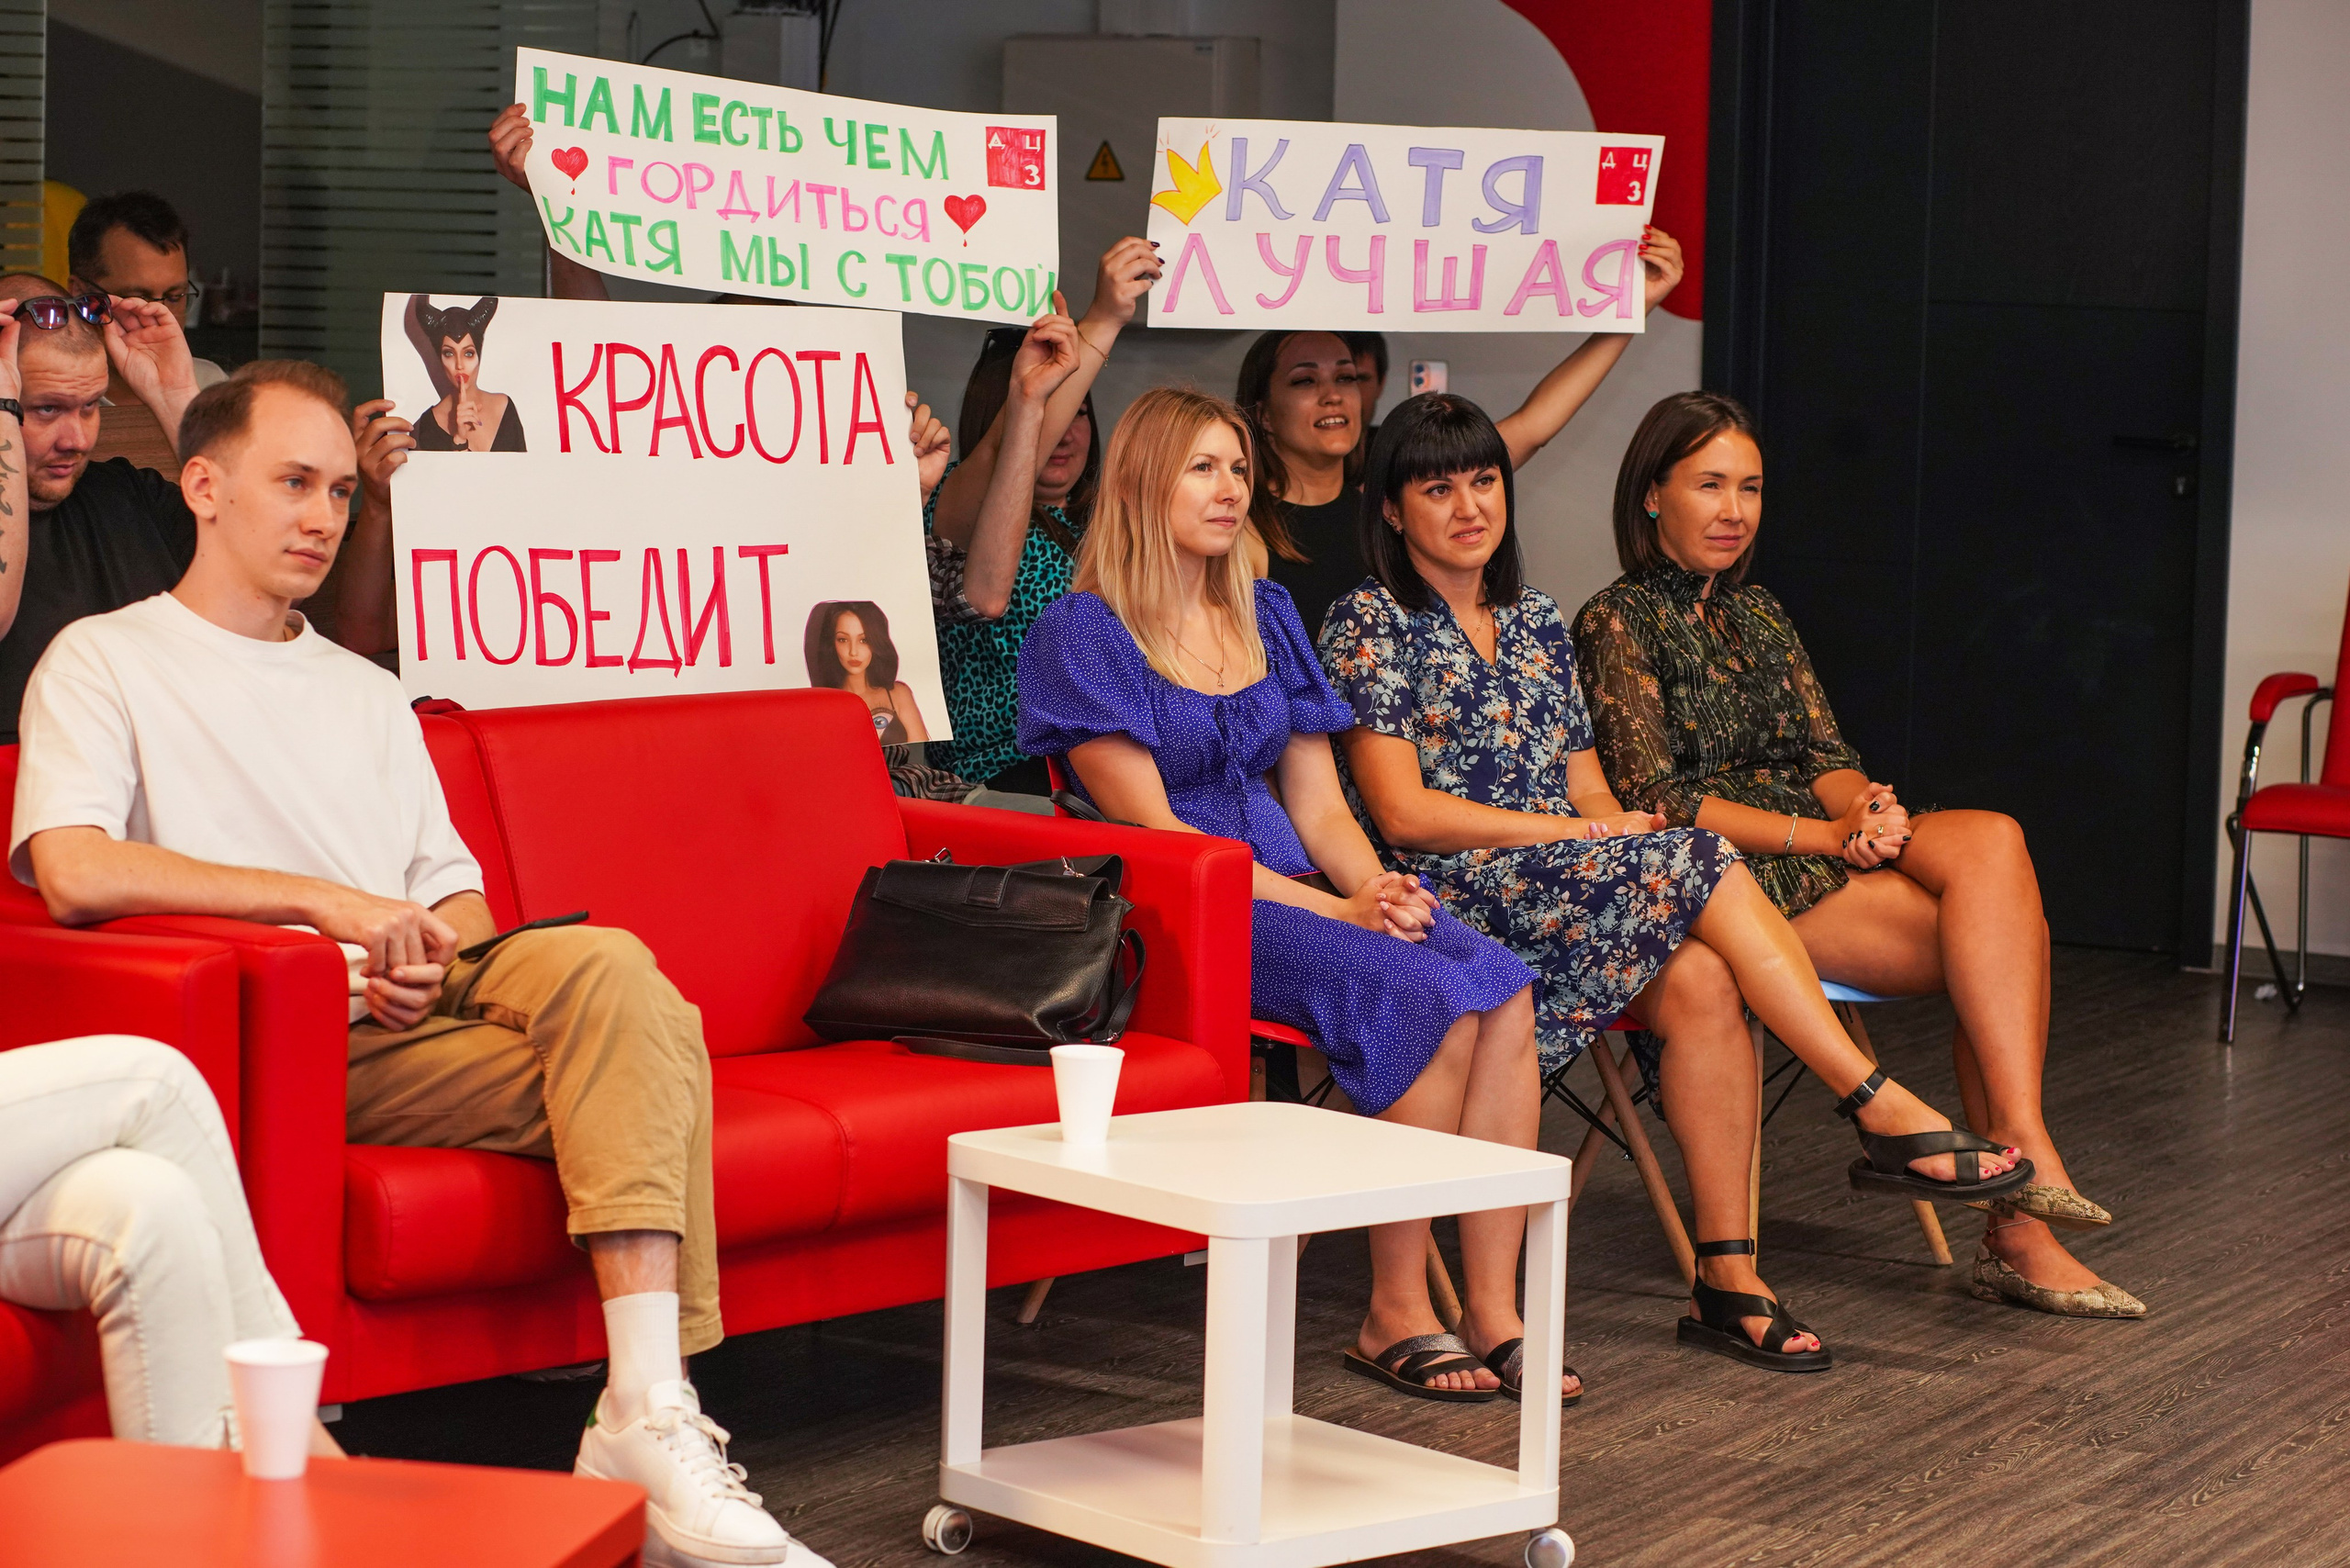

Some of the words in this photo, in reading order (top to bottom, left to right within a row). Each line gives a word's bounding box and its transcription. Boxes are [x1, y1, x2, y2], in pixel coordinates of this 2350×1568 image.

[532, 65, 673, 143] НАМ
[692, 93, 803, 154] ЕСТЬ
[822, 117, 949, 181] ЧЕМ
[607, 154, 931, 243] ГОРДИТЬСЯ
[1225, 137, 1544, 235] КАТЯ
[541, 196, 684, 275] КАТЯ
[720, 230, 810, 291] МЫ
[837, 250, 867, 298] С
[885, 253, 1056, 318] ТОБОЙ
[1162, 232, 1639, 319] ЛУЧШАЯ
[551, 342, 895, 465] КРАСОТА
[411, 544, 789, 678] ПОБЕДИТ
